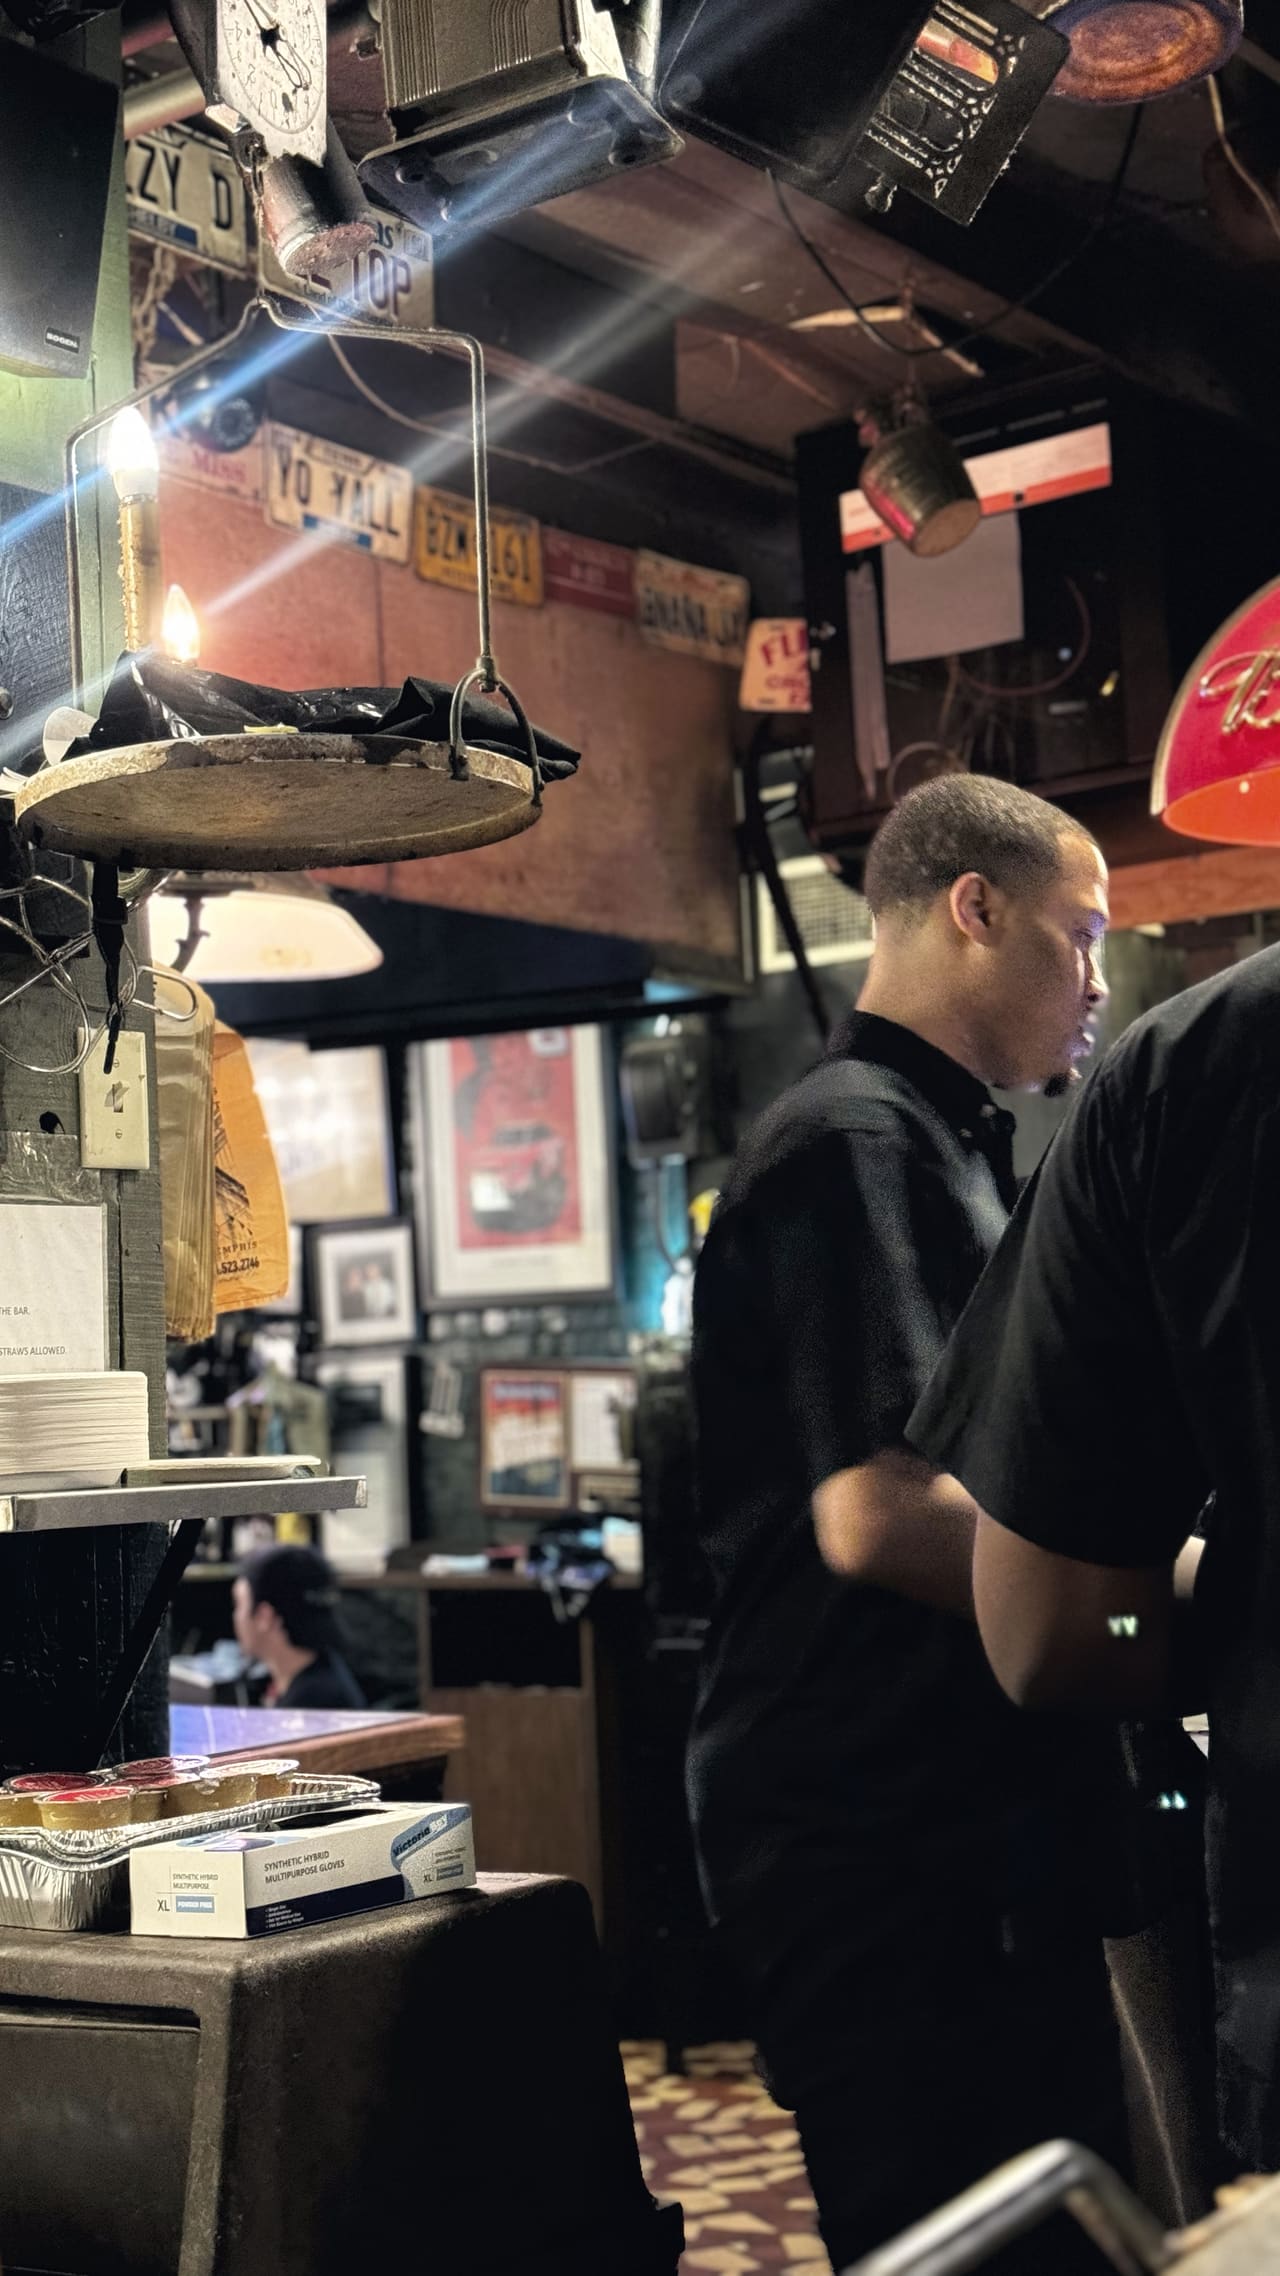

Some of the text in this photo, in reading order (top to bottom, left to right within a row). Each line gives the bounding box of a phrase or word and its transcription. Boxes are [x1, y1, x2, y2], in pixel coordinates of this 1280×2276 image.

[277, 444, 312, 506] YO
[264, 1850, 330, 1872] SYNTHETIC HYBRID
[173, 1873, 199, 1881] SYNTHETIC
[265, 1859, 345, 1884] MULTIPURPOSE GLOVES
[173, 1882, 210, 1890] MULTIPURPOSE
[157, 1899, 171, 1912] XL
